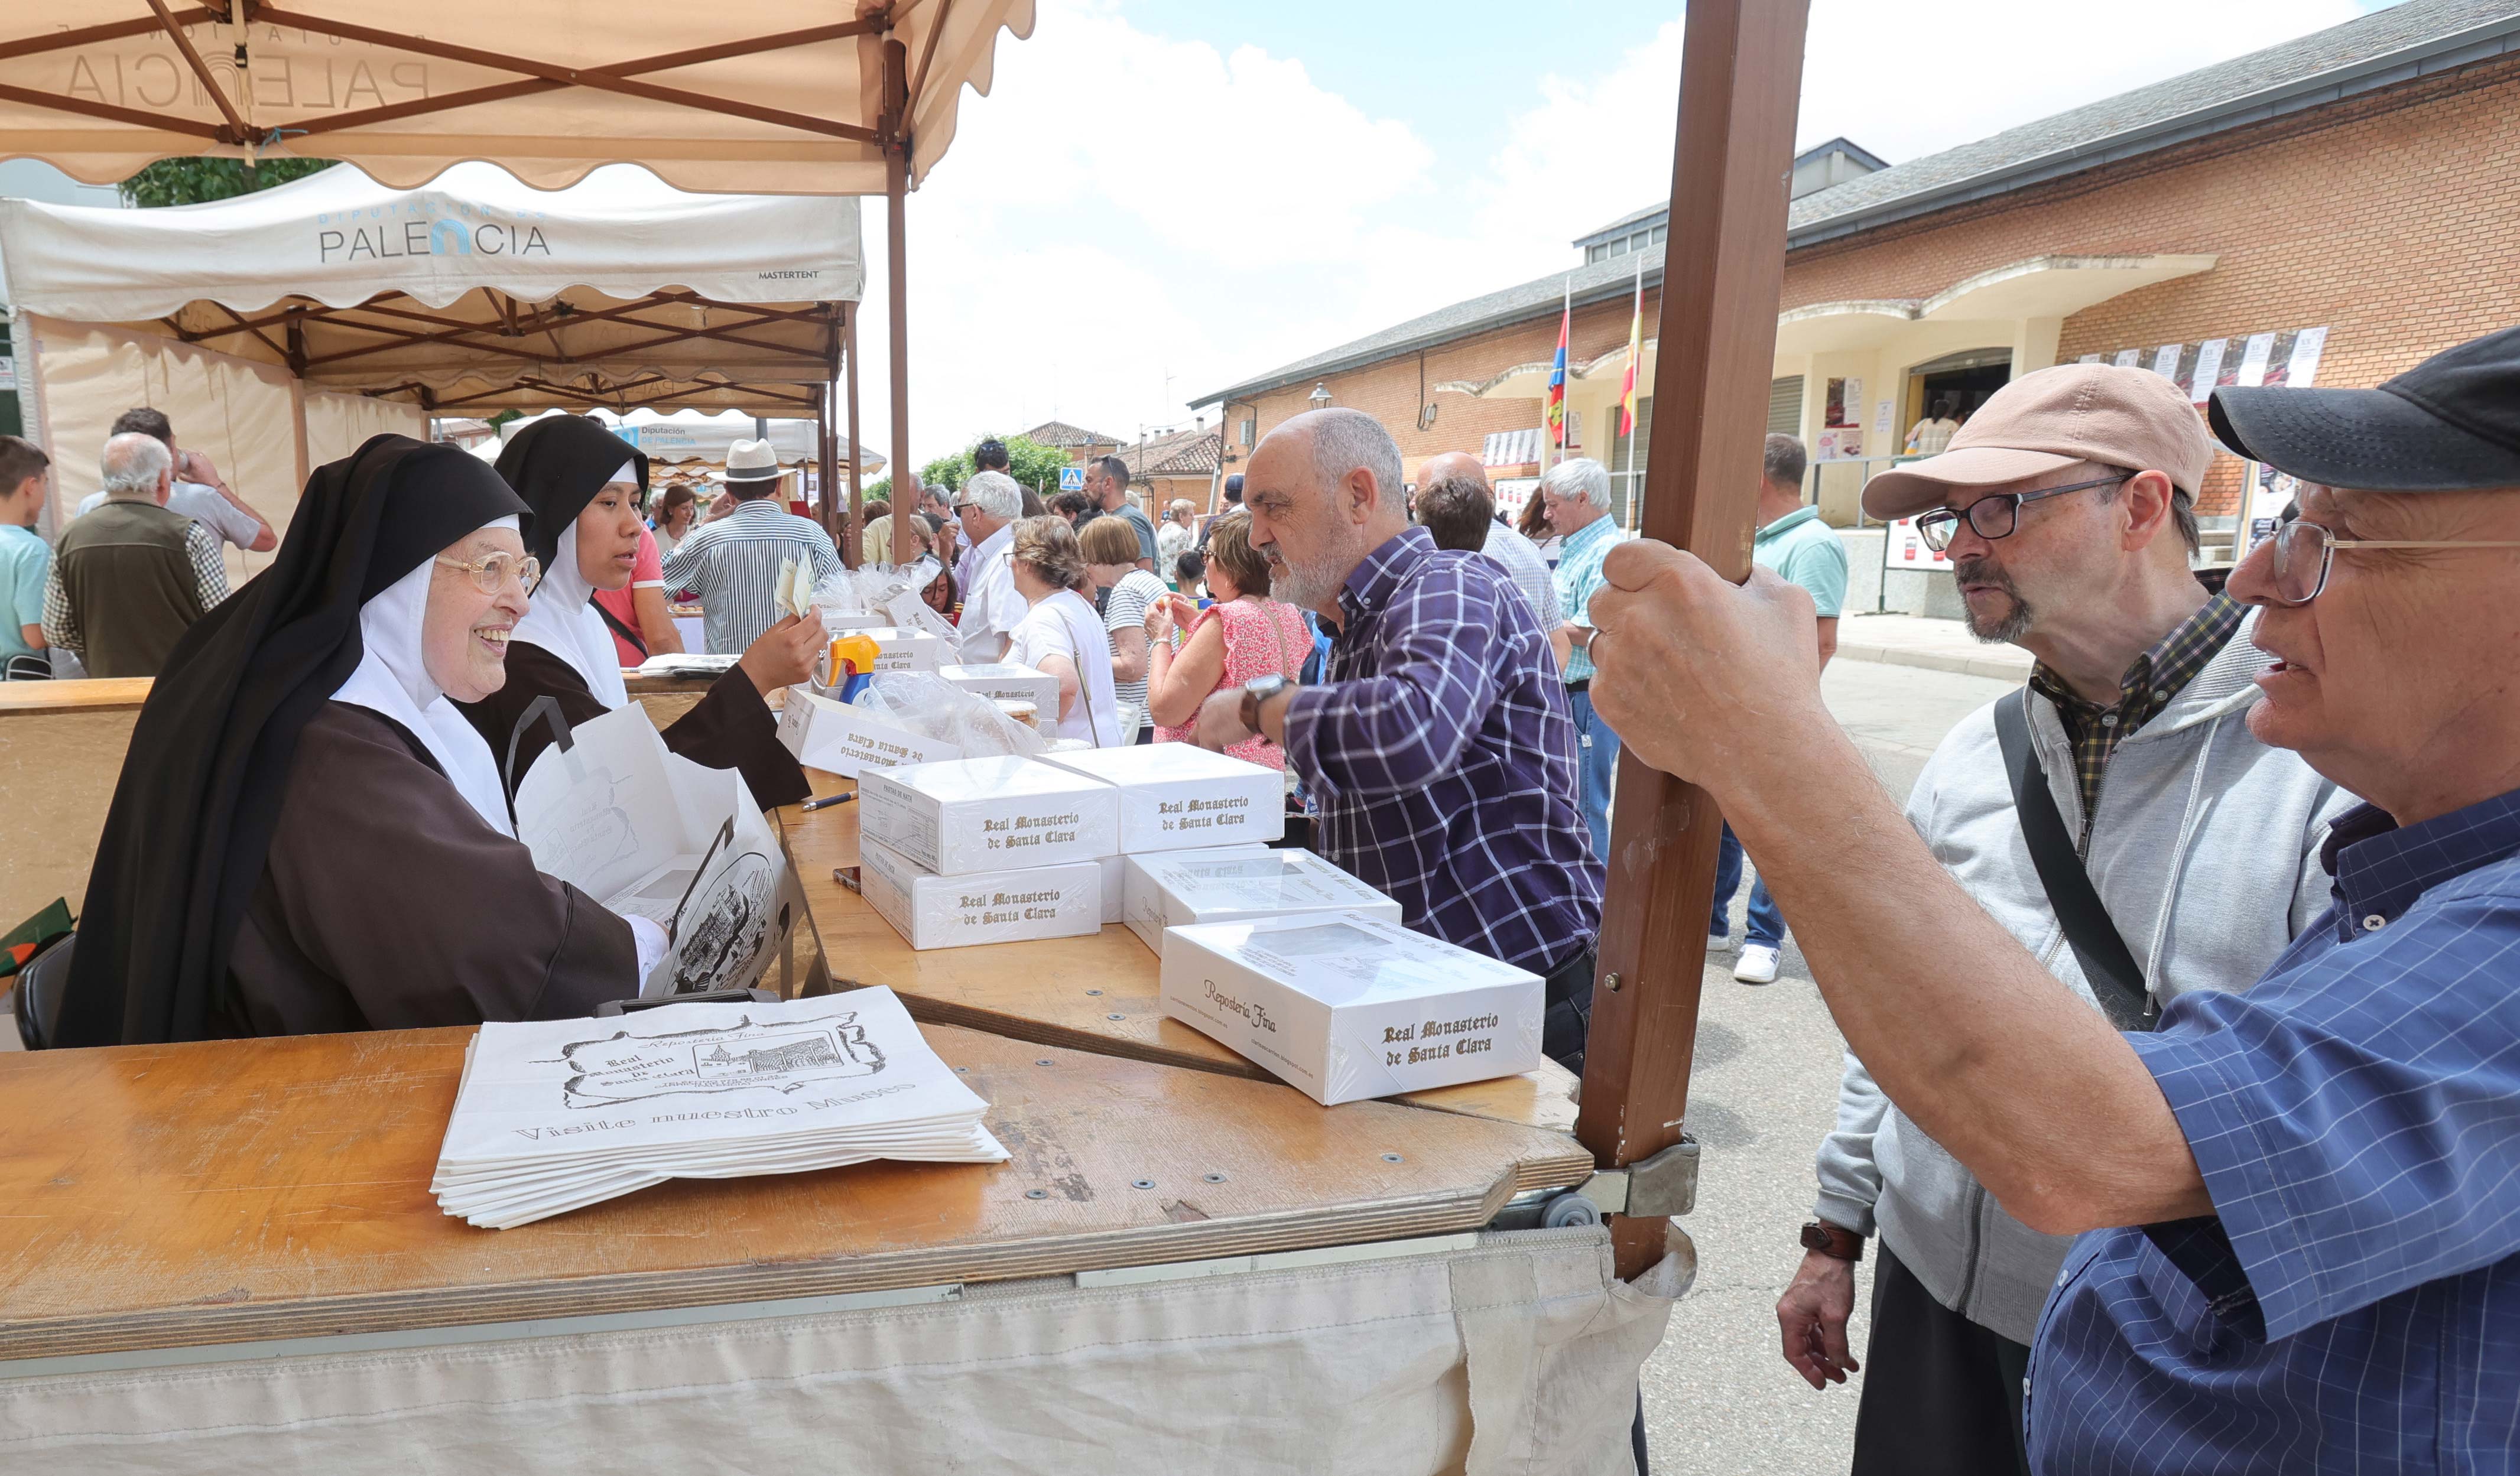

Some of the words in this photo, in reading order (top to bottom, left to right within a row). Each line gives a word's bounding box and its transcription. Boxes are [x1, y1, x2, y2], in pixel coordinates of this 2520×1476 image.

[758, 271, 819, 279] MASTERTENT
[642, 427, 686, 435] Diputación
[994, 690, 1034, 698] Monasterio
[847, 733, 875, 749] Clara
[878, 741, 908, 757] Santa
[912, 751, 923, 762] de
[1158, 801, 1183, 814] Real
[1187, 796, 1249, 813] Monasterio
[983, 818, 1009, 832] Real
[1015, 812, 1079, 830] Monasterio
[1162, 820, 1174, 831] de
[1179, 817, 1212, 830] Santa
[1216, 813, 1245, 825] Clara
[988, 838, 1000, 850] de
[1006, 834, 1040, 848] Santa
[1045, 830, 1076, 843] Clara
[959, 894, 986, 908] Real
[992, 889, 1060, 907] Monasterio
[964, 913, 977, 925] de
[982, 911, 1019, 925] Santa
[1024, 907, 1056, 919] Clara
[1204, 979, 1251, 1019] Repostería
[1251, 1004, 1277, 1033] Fina
[728, 1031, 765, 1040] Fina
[1381, 1023, 1415, 1044] Real
[1420, 1012, 1498, 1040] Monasterio
[605, 1055, 642, 1067] Real
[1386, 1051, 1401, 1067] de
[1408, 1043, 1450, 1065] Santa
[1456, 1037, 1492, 1055] Clara
[589, 1057, 674, 1077] Monasterio
[600, 1077, 649, 1087] Santa
[652, 1068, 695, 1078] Clara
[512, 1119, 637, 1140] Visite
[650, 1105, 798, 1123] nuestro
[802, 1082, 917, 1111] Museo
